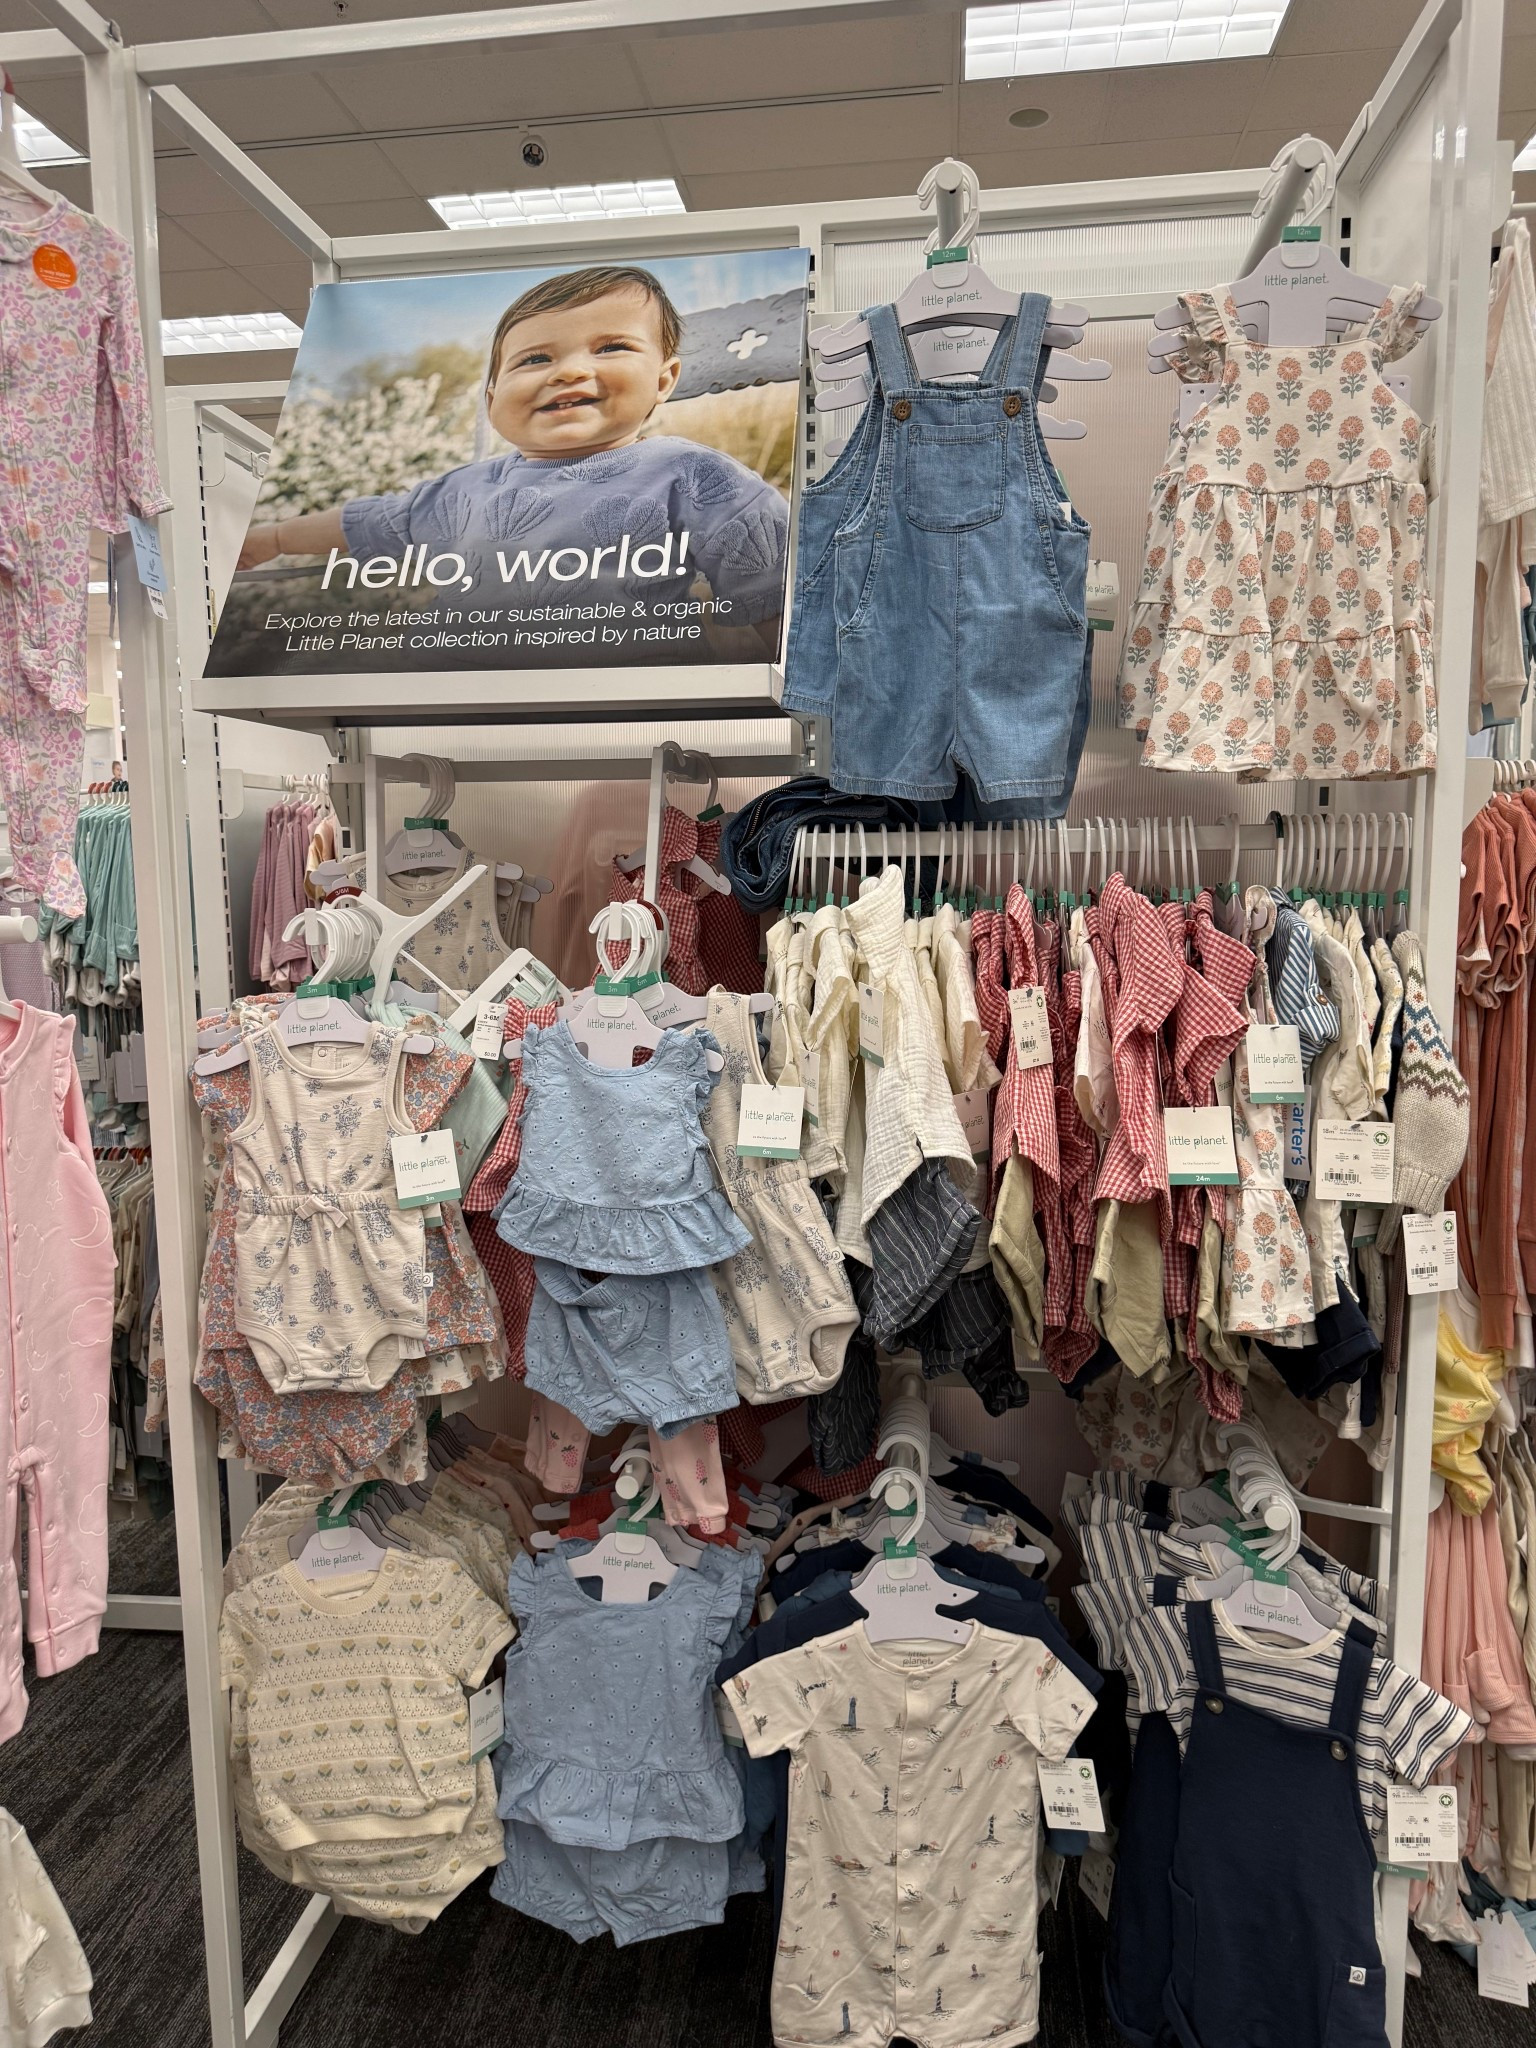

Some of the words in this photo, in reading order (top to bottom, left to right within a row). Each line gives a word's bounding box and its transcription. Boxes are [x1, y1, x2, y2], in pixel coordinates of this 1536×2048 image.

[1297, 228, 1312, 236] 12m
[1264, 274, 1288, 287] little
[921, 294, 944, 307] little
[933, 341, 954, 352] little
[320, 543, 474, 593] hello,
[496, 531, 690, 583] world!
[264, 612, 342, 632] Explore
[347, 611, 380, 627] the
[385, 609, 441, 626] latest
[445, 608, 463, 624] in
[468, 610, 504, 623] our
[507, 602, 626, 622] sustainable
[631, 600, 648, 618] &
[652, 597, 733, 619] organic
[285, 635, 335, 651] Little
[339, 633, 406, 650] Planet
[410, 630, 509, 648] collection
[514, 626, 596, 648] inspired
[601, 625, 629, 646] by
[633, 623, 701, 641] nature
[401, 850, 419, 861] little
[306, 986, 318, 994] 3m
[607, 985, 618, 993] 3m
[287, 1023, 307, 1035] little
[587, 1018, 605, 1030] little
[1253, 1053, 1271, 1064] little
[745, 1109, 764, 1120] little
[1291, 1102, 1306, 1166] arter's
[1168, 1135, 1191, 1146] little
[398, 1160, 419, 1172] little
[327, 1518, 339, 1526] 9m
[625, 1523, 637, 1531] 12m
[311, 1556, 332, 1568] little
[602, 1555, 623, 1567] little
[1264, 1571, 1277, 1580] 9m
[877, 1583, 897, 1595] little
[1244, 1603, 1265, 1617] little
[1386, 1865, 1399, 1873] 18m
